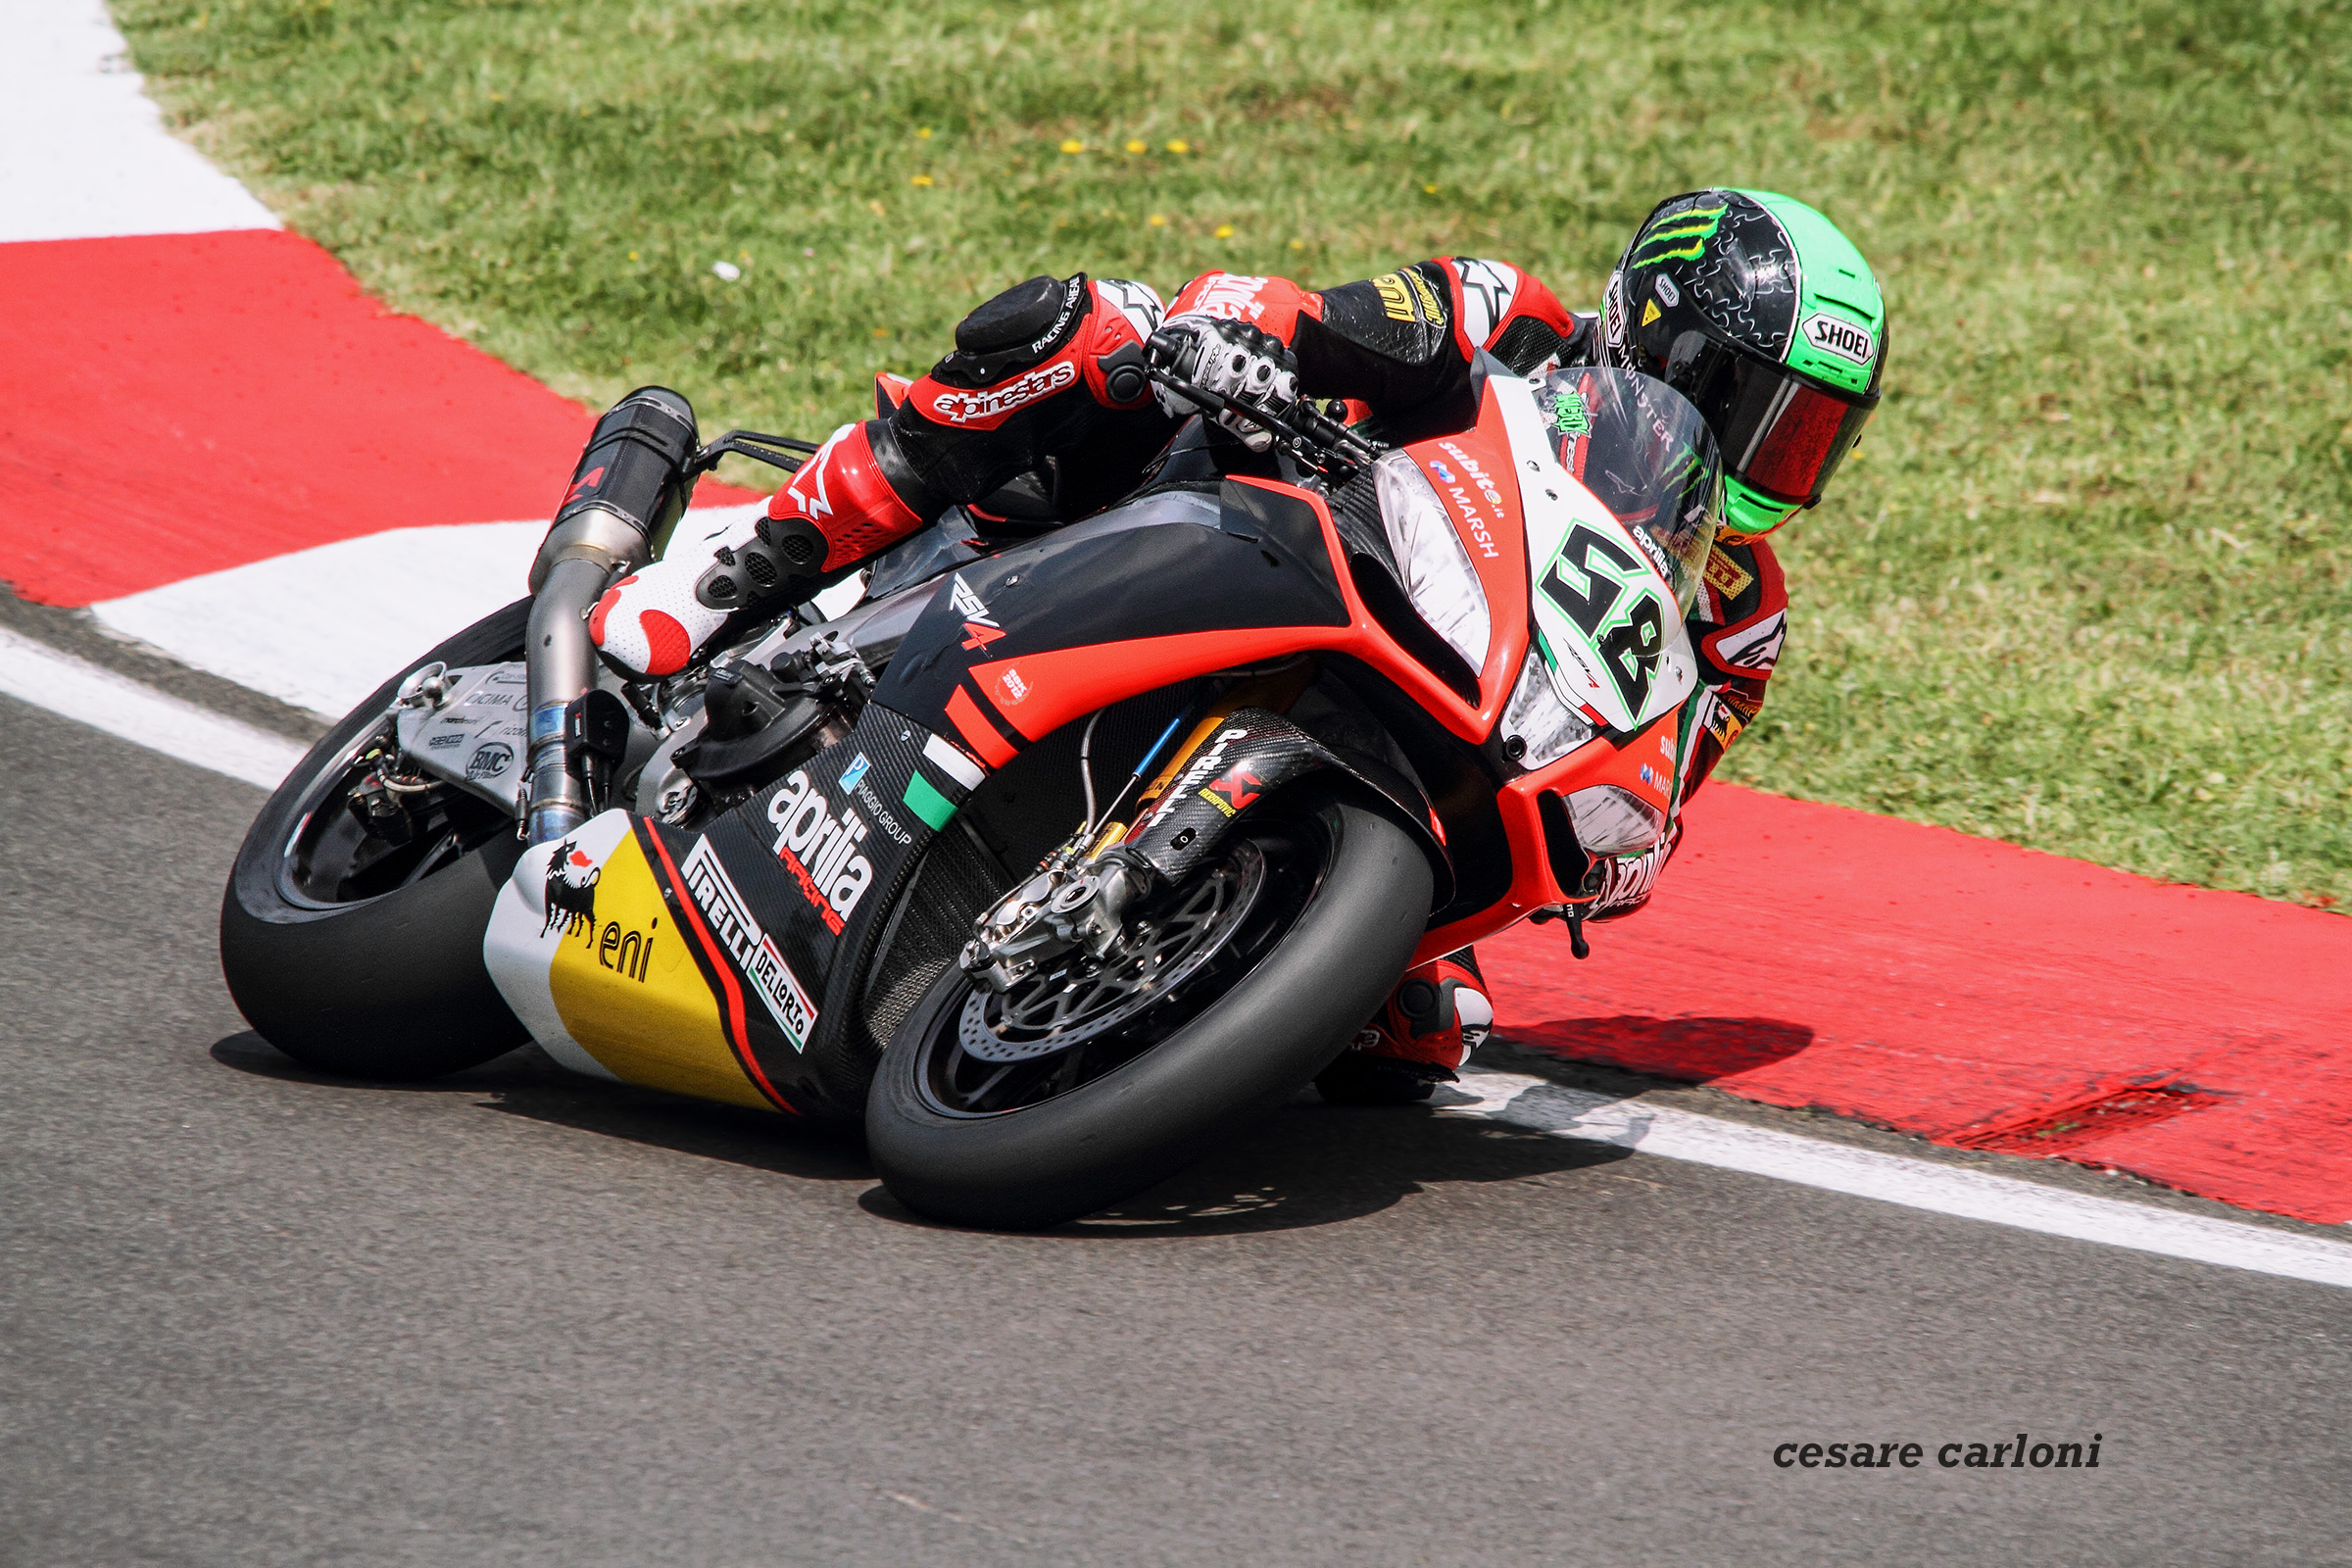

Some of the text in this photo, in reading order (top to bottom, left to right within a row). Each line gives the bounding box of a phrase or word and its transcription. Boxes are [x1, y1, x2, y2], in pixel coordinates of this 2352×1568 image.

[1608, 280, 1622, 339] SHOEI
[1659, 278, 1676, 302] SHOEI
[1032, 312, 1070, 353] RACING
[1815, 320, 1868, 358] SHOEI
[934, 361, 1075, 422] alpinestars
[1618, 344, 1674, 452] MONSTER
[1448, 488, 1498, 558] MARSH
[1633, 525, 1668, 578] aprilia
[1537, 519, 1664, 728] 58
[1003, 674, 1022, 700] 2012
[1009, 668, 1027, 693] SBK
[470, 752, 510, 772] BMC
[1147, 729, 1248, 827] PIRELLI
[856, 779, 911, 844] PIAGGIO GROUP
[767, 770, 873, 921] aprilia
[681, 834, 761, 970] PIRELLI
[599, 917, 658, 983] eni
